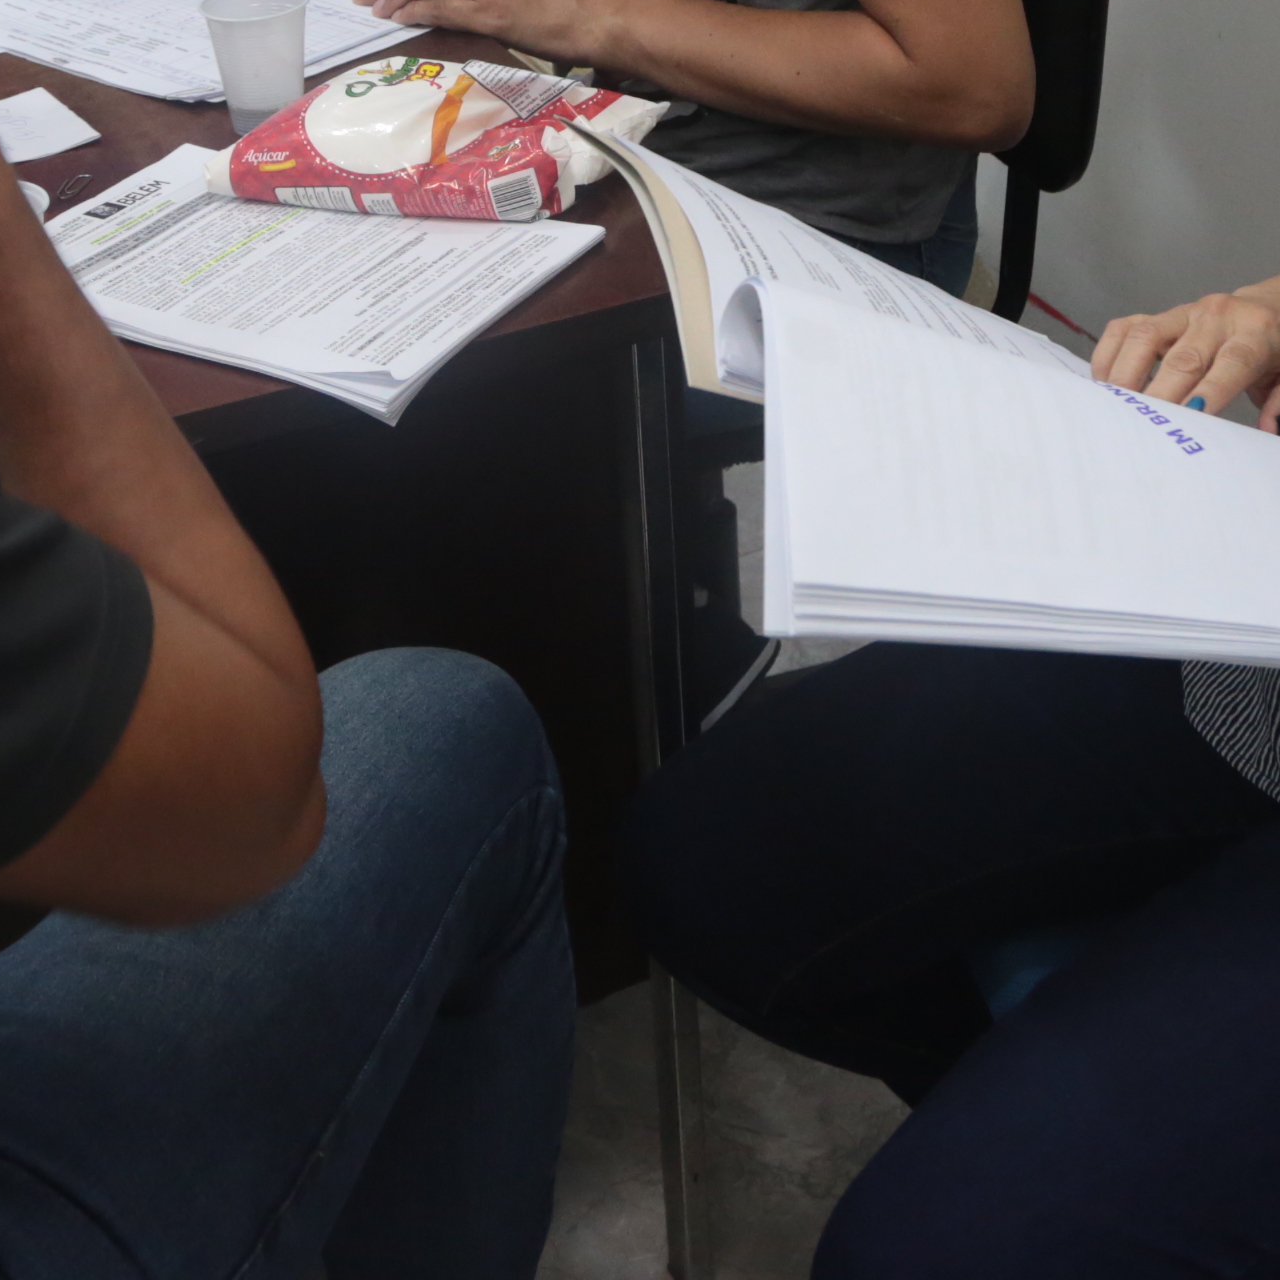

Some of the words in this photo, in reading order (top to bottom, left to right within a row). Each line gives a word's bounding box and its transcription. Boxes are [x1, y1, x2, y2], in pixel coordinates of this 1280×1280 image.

[242, 148, 290, 163] Açúcar
[119, 180, 171, 208] BELÉM
[1166, 429, 1205, 455] EM
